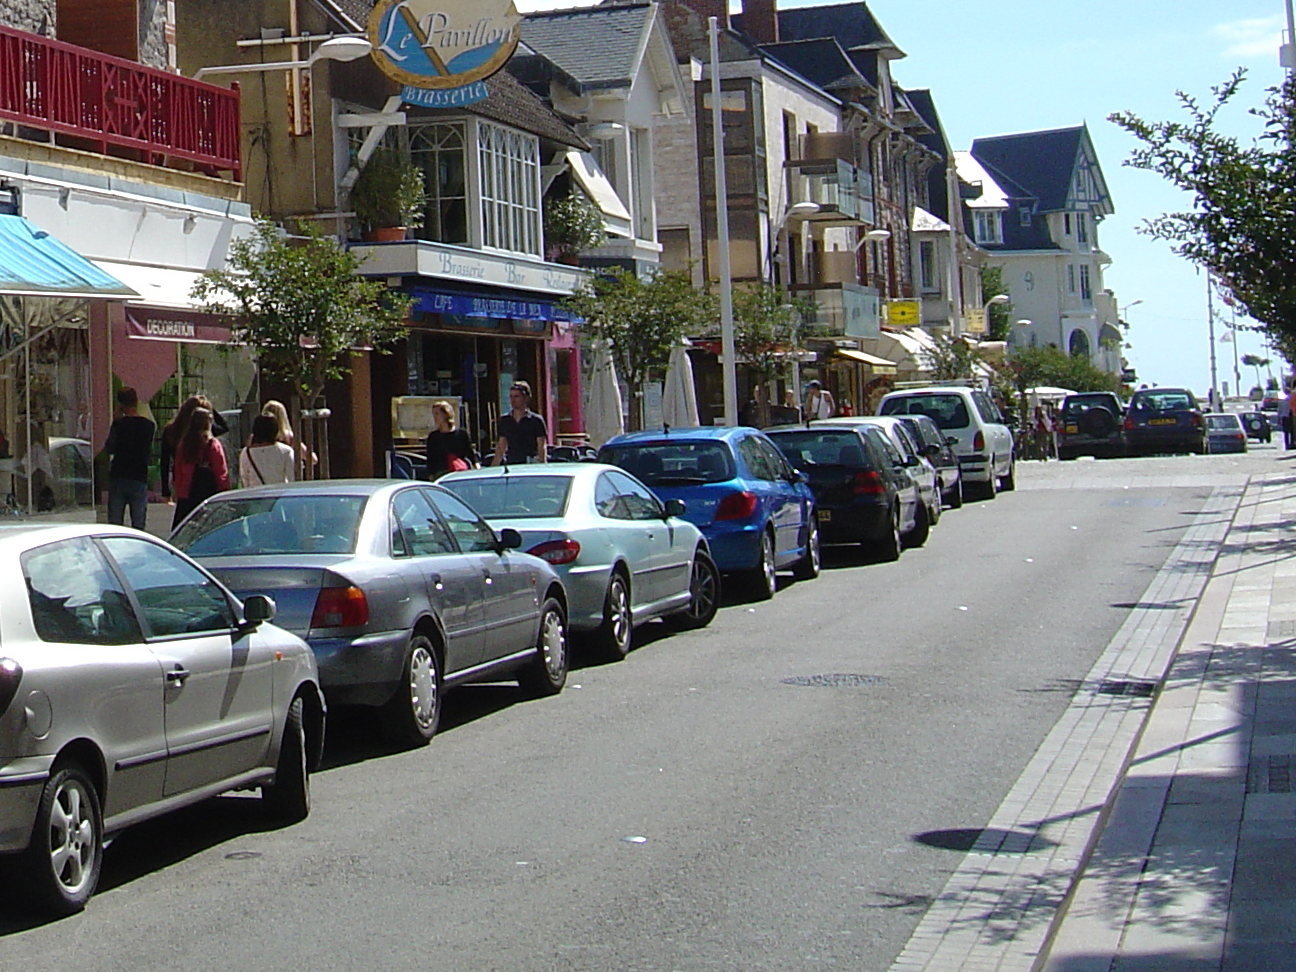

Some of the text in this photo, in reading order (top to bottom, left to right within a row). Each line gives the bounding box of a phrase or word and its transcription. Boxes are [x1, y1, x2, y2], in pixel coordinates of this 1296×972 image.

[378, 0, 515, 62] Le Pavillon
[405, 81, 483, 104] Brasserie
[439, 250, 485, 279] Brasserie
[505, 261, 526, 283] Bar
[147, 318, 195, 337] DECORATION
